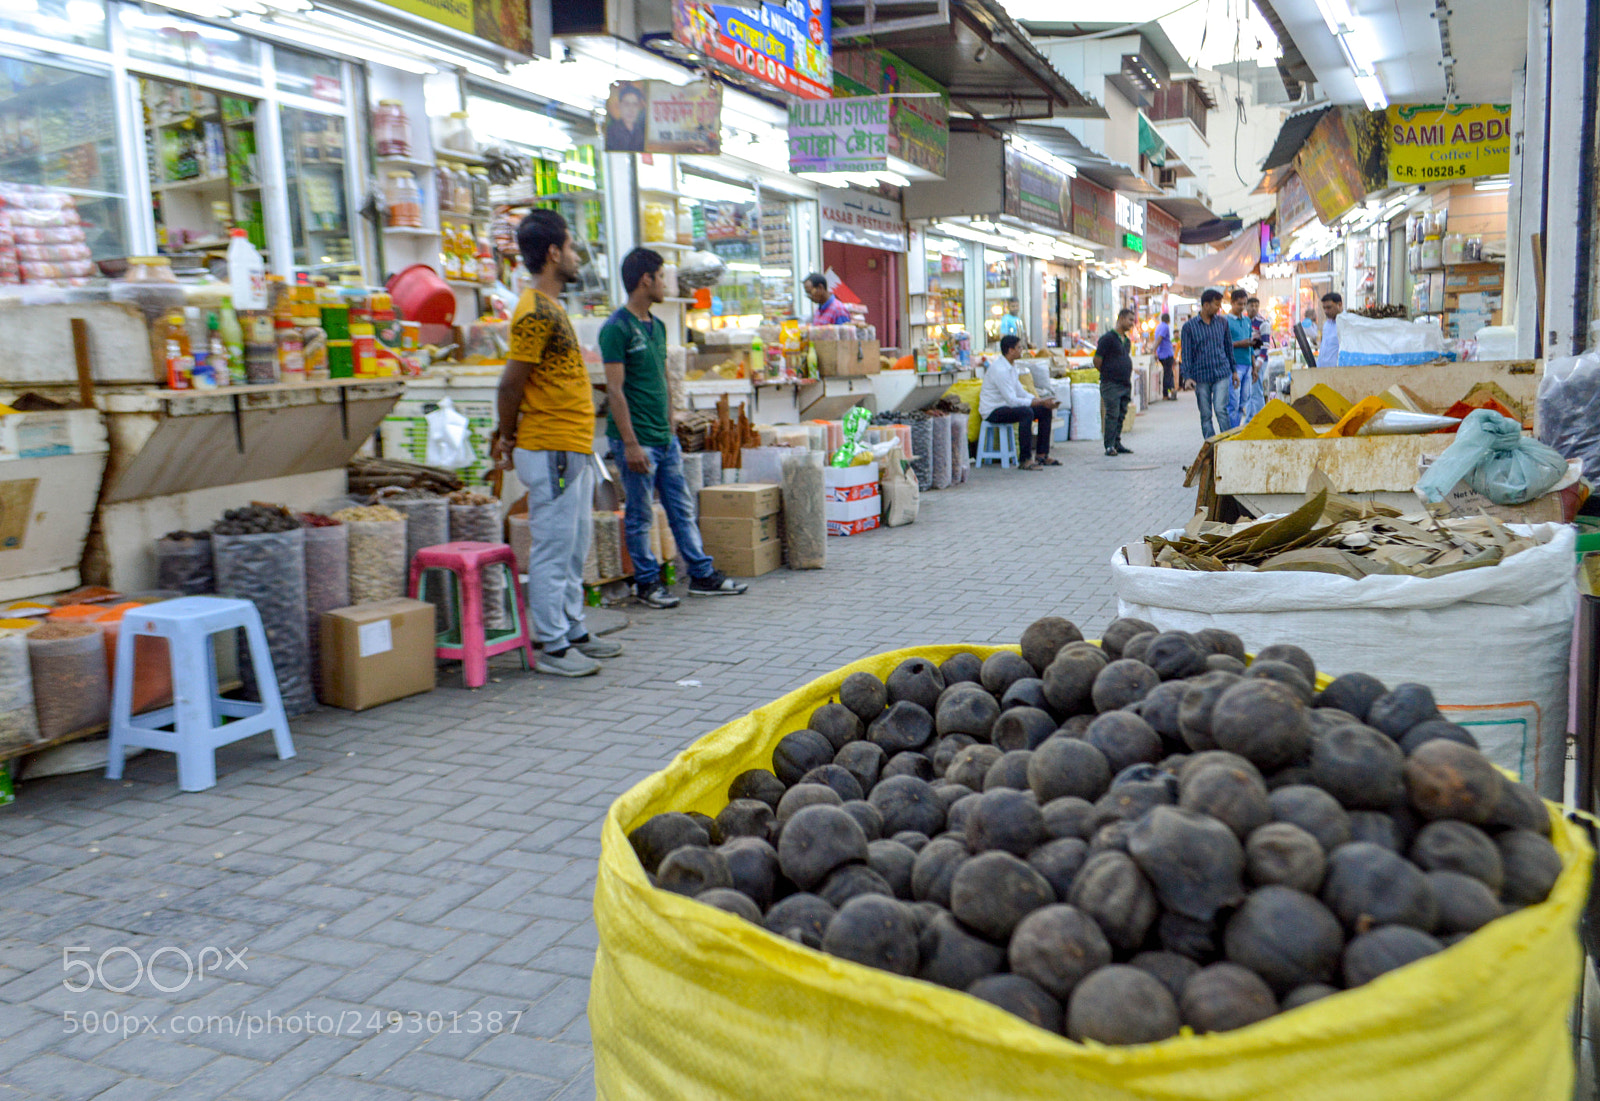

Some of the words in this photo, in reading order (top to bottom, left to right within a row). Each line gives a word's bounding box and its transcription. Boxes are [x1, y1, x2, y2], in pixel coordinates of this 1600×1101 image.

[788, 102, 841, 127] MULLAH
[845, 100, 888, 125] STORE
[1393, 124, 1444, 146] SAMI
[1430, 149, 1473, 161] Coffee
[1421, 164, 1466, 178] 10528-5
[822, 206, 853, 225] KASAB
[856, 214, 904, 234] RESTAURAN
